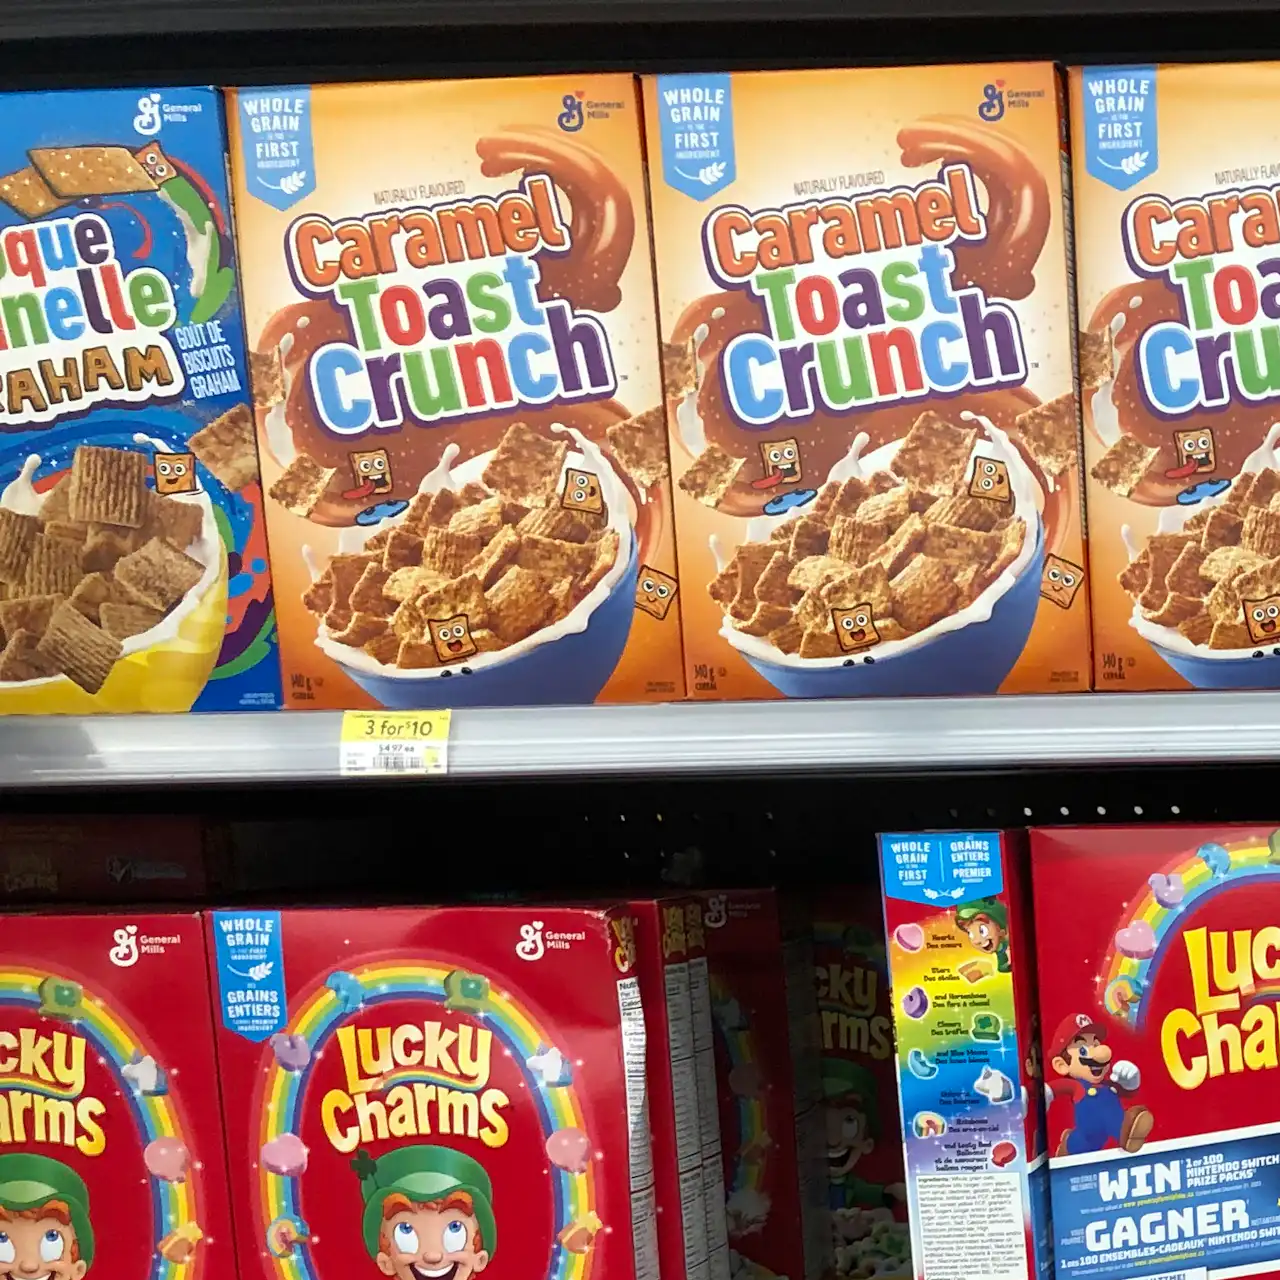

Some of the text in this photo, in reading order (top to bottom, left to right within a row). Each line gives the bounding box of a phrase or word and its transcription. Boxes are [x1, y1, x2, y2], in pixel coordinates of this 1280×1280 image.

[1089, 78, 1149, 95] WHOLE
[1096, 97, 1144, 113] GRAIN
[1098, 122, 1142, 138] FIRST
[1215, 167, 1258, 185] NATURALLY
[713, 168, 979, 277] Caramel
[297, 178, 563, 286] Caramel
[0, 219, 108, 287] que
[340, 256, 544, 345] Toast
[757, 245, 958, 340] Toast
[0, 265, 171, 349] nelle
[210, 320, 225, 343] DE
[183, 345, 235, 375] BISCUITS
[726, 294, 1021, 419] Crunch
[316, 307, 609, 430] Crunch
[0, 345, 174, 413] AHAM
[190, 370, 241, 399] GRAHAM
[366, 720, 432, 736] 3 for $10
[892, 842, 931, 853] WHOLE
[951, 841, 989, 851] GRAINS
[896, 853, 928, 864] GRAIN
[952, 851, 990, 863] ENTIERS
[899, 870, 927, 881] FIRST
[953, 868, 992, 878] PREMIER
[220, 918, 273, 934] WHOLE
[226, 933, 270, 947] GRAIN
[545, 932, 586, 942] General
[545, 940, 570, 951] Mills
[227, 990, 278, 1004] GRAINS
[227, 1004, 281, 1019] ENTIERS
[335, 1020, 493, 1095] Lucky
[321, 1081, 510, 1154] Charms
